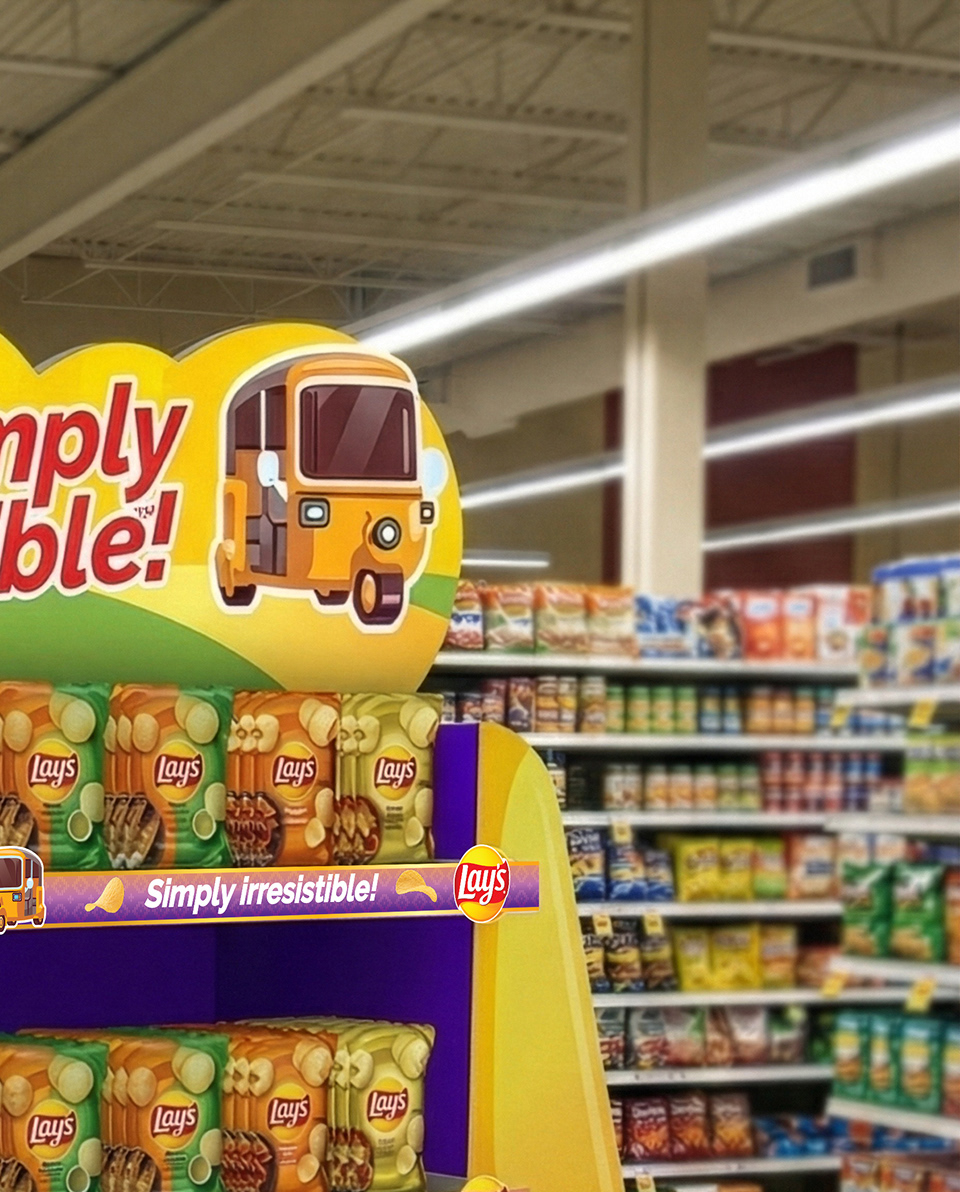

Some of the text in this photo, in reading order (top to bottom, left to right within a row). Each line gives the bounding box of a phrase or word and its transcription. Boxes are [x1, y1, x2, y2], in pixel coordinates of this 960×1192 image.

[144, 873, 380, 915] Simply irresistible!
[457, 863, 507, 906] Lay's
